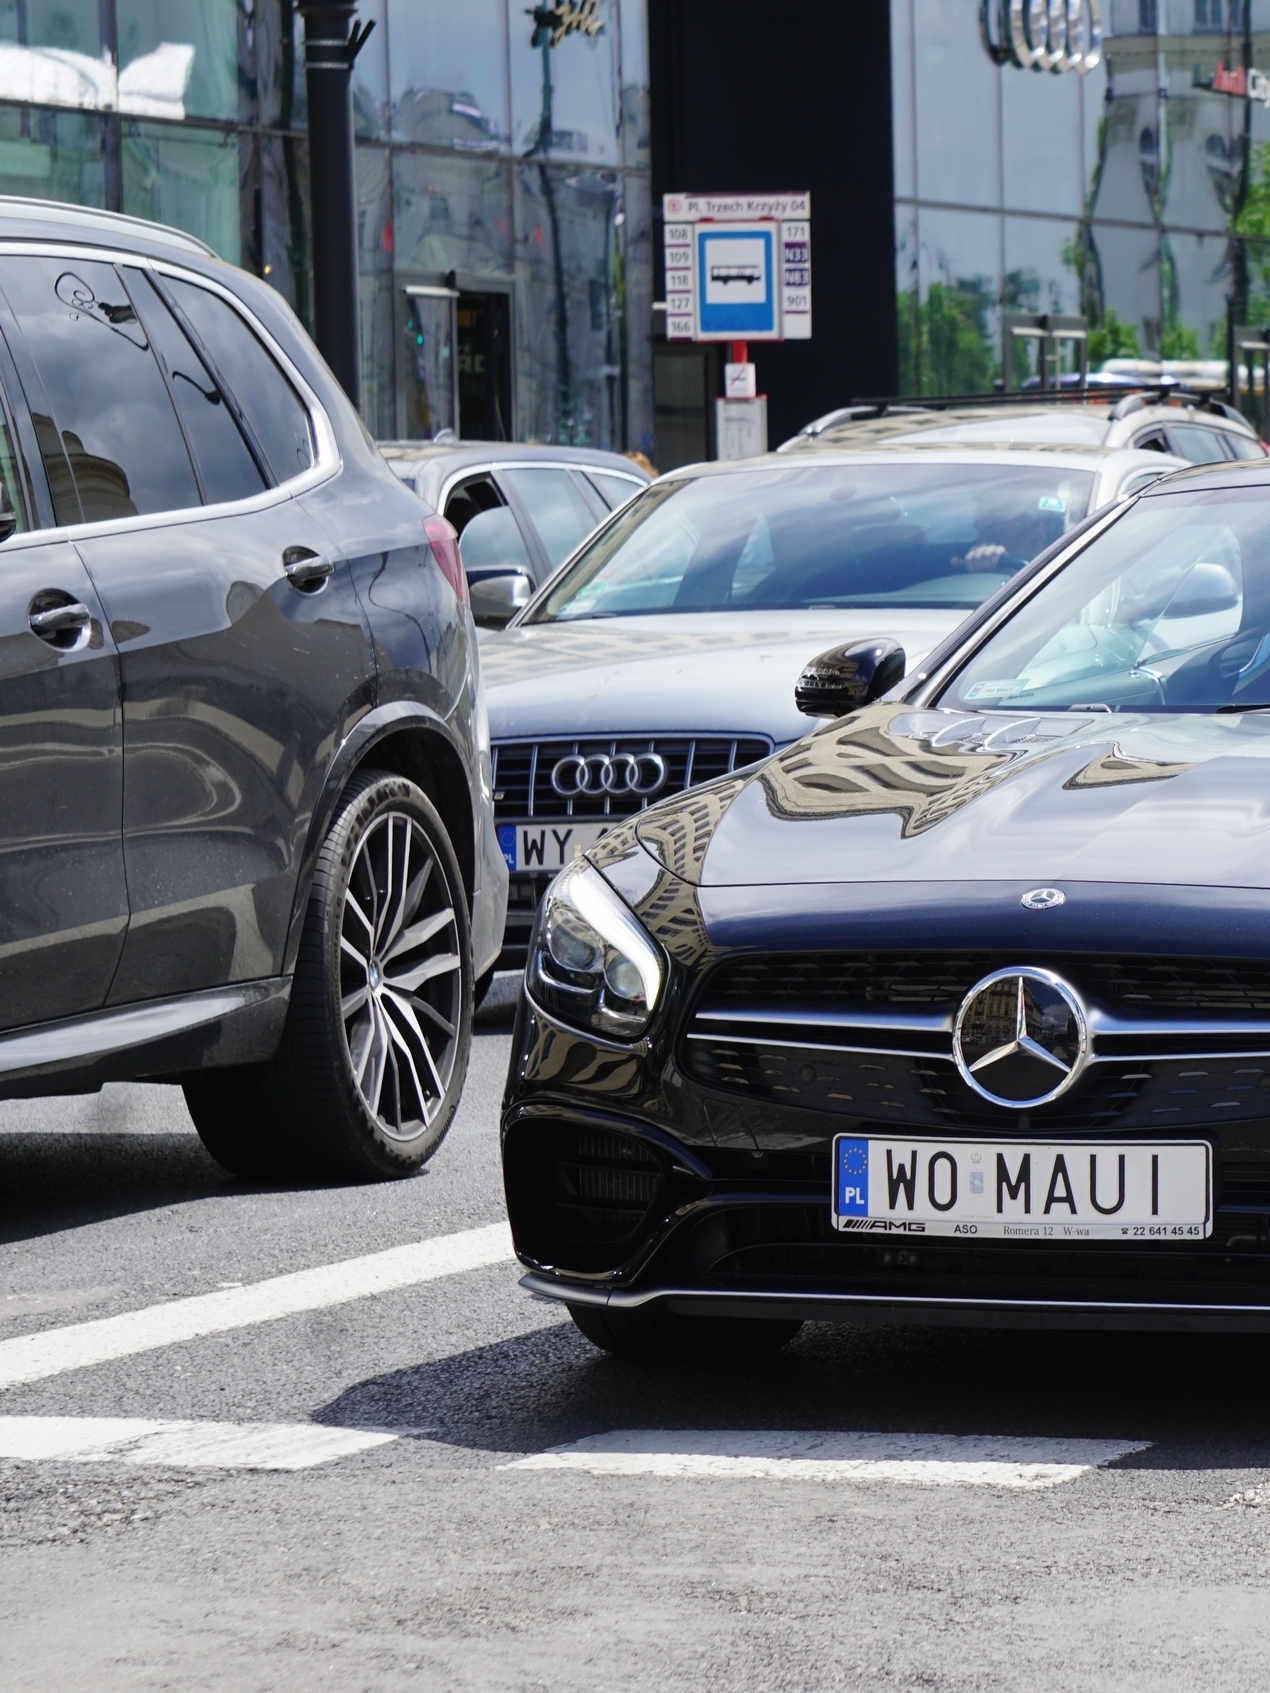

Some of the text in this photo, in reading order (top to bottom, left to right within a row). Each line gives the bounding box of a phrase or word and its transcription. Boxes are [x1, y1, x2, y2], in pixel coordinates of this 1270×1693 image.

[705, 201, 743, 213] Trzech
[747, 200, 788, 215] Krzyży
[669, 229, 689, 241] 108
[787, 226, 805, 238] 171
[669, 252, 690, 264] 109
[671, 275, 689, 287] 118
[671, 297, 690, 310] 127
[671, 321, 691, 333] 166
[523, 828, 573, 866] WY
[886, 1149, 1159, 1216] WO MAUI
[845, 1186, 865, 1205] PL
[953, 1224, 978, 1234] ASO
[1003, 1225, 1040, 1236] Romera
[1043, 1226, 1054, 1236] 12
[1063, 1226, 1090, 1236] W-wa
[1133, 1226, 1146, 1236] 22
[1149, 1226, 1168, 1236] 641
[1171, 1226, 1184, 1236] 45
[1187, 1226, 1200, 1236] 45
